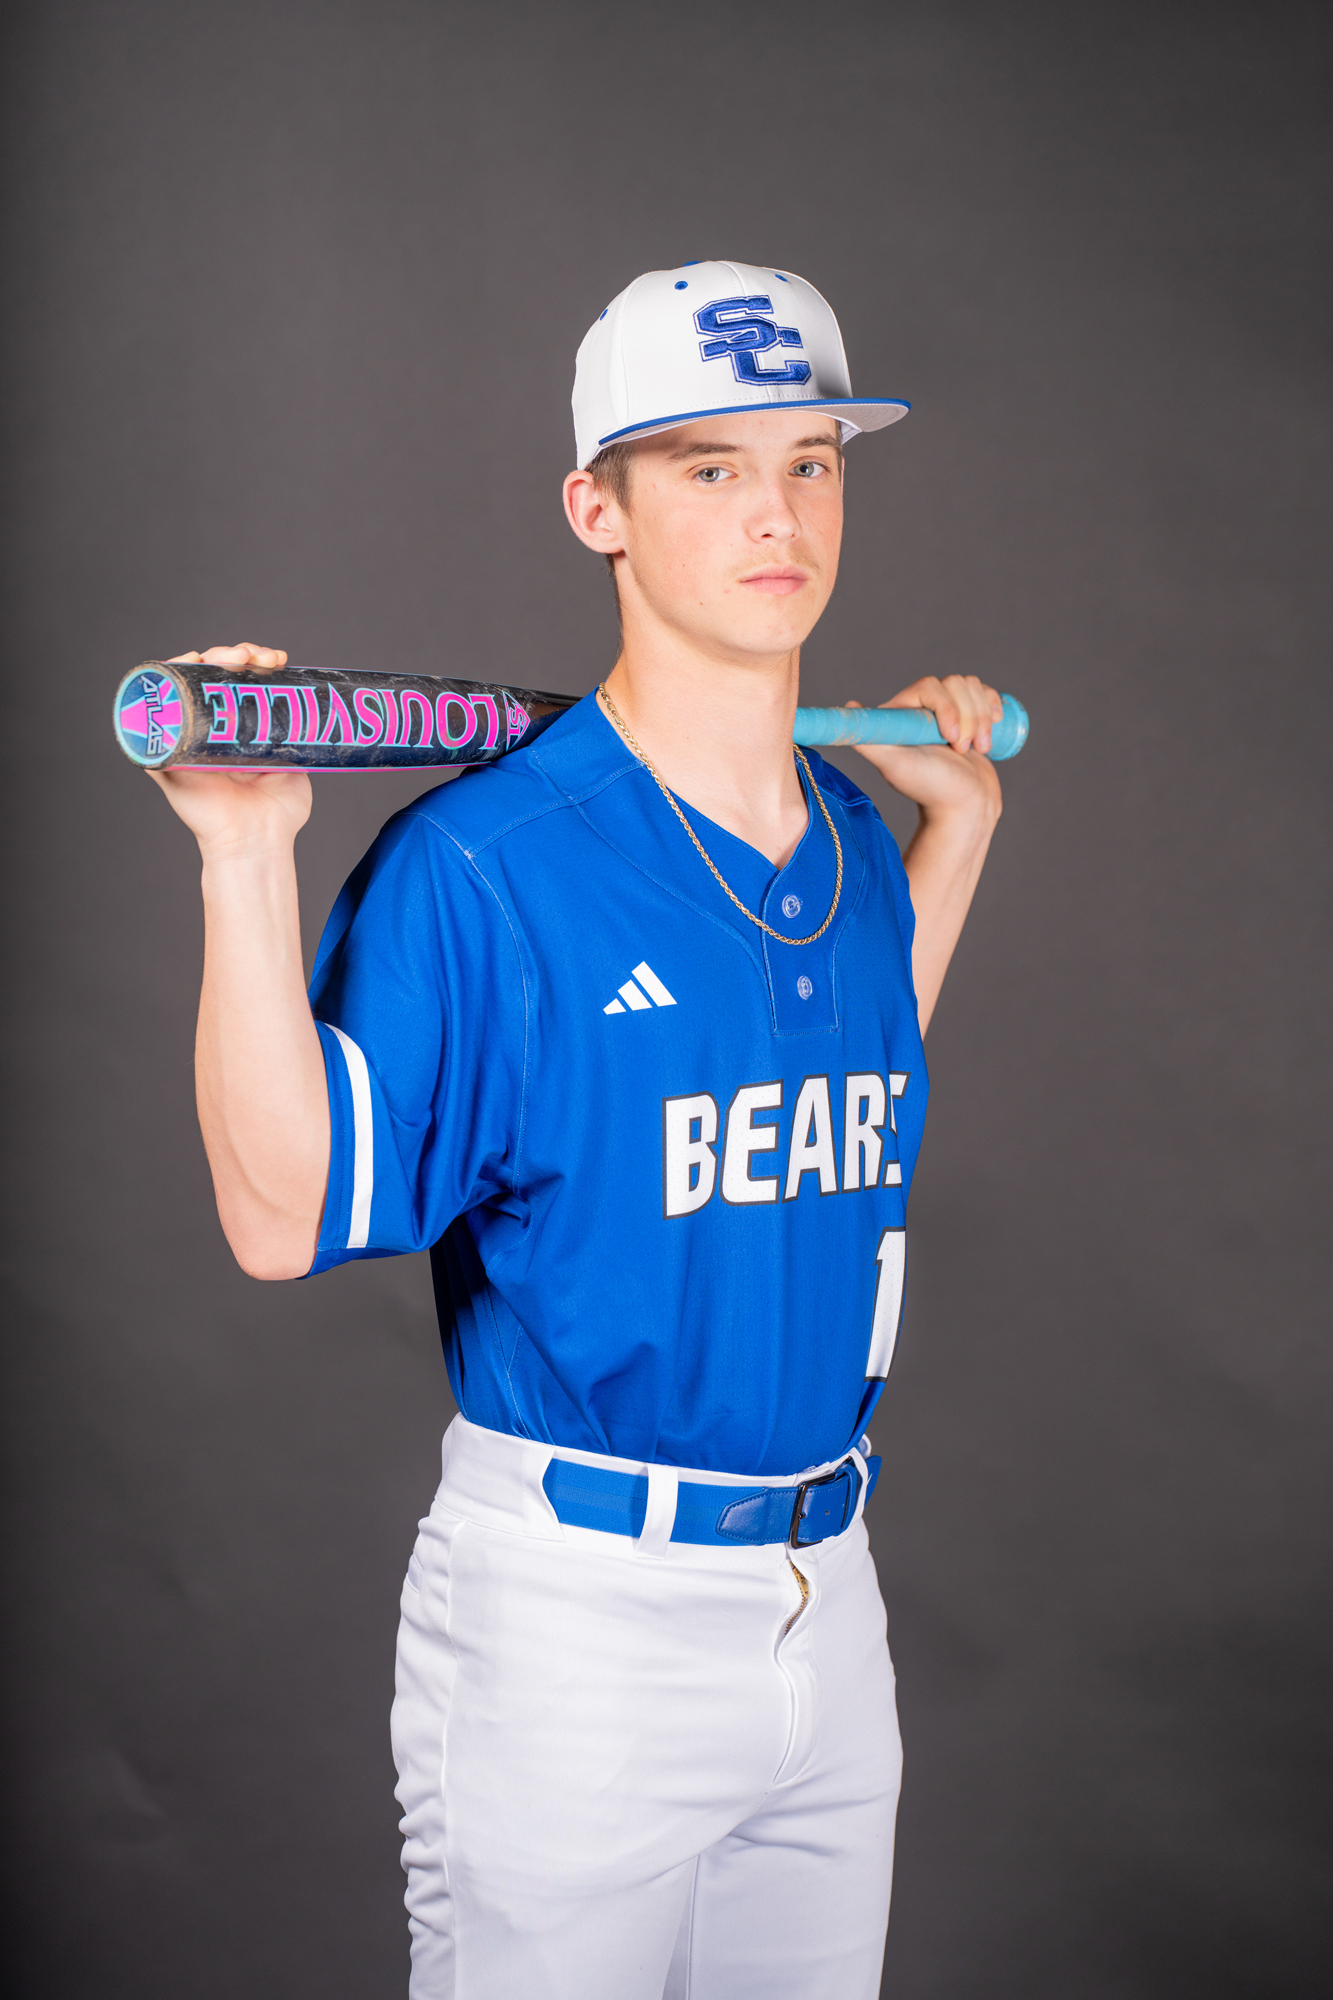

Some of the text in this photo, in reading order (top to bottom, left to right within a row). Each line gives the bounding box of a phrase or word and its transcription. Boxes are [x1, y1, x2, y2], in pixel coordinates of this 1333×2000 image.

[693, 295, 811, 386] SC
[140, 674, 163, 756] ATLAS
[201, 682, 499, 750] LOUISVILLE
